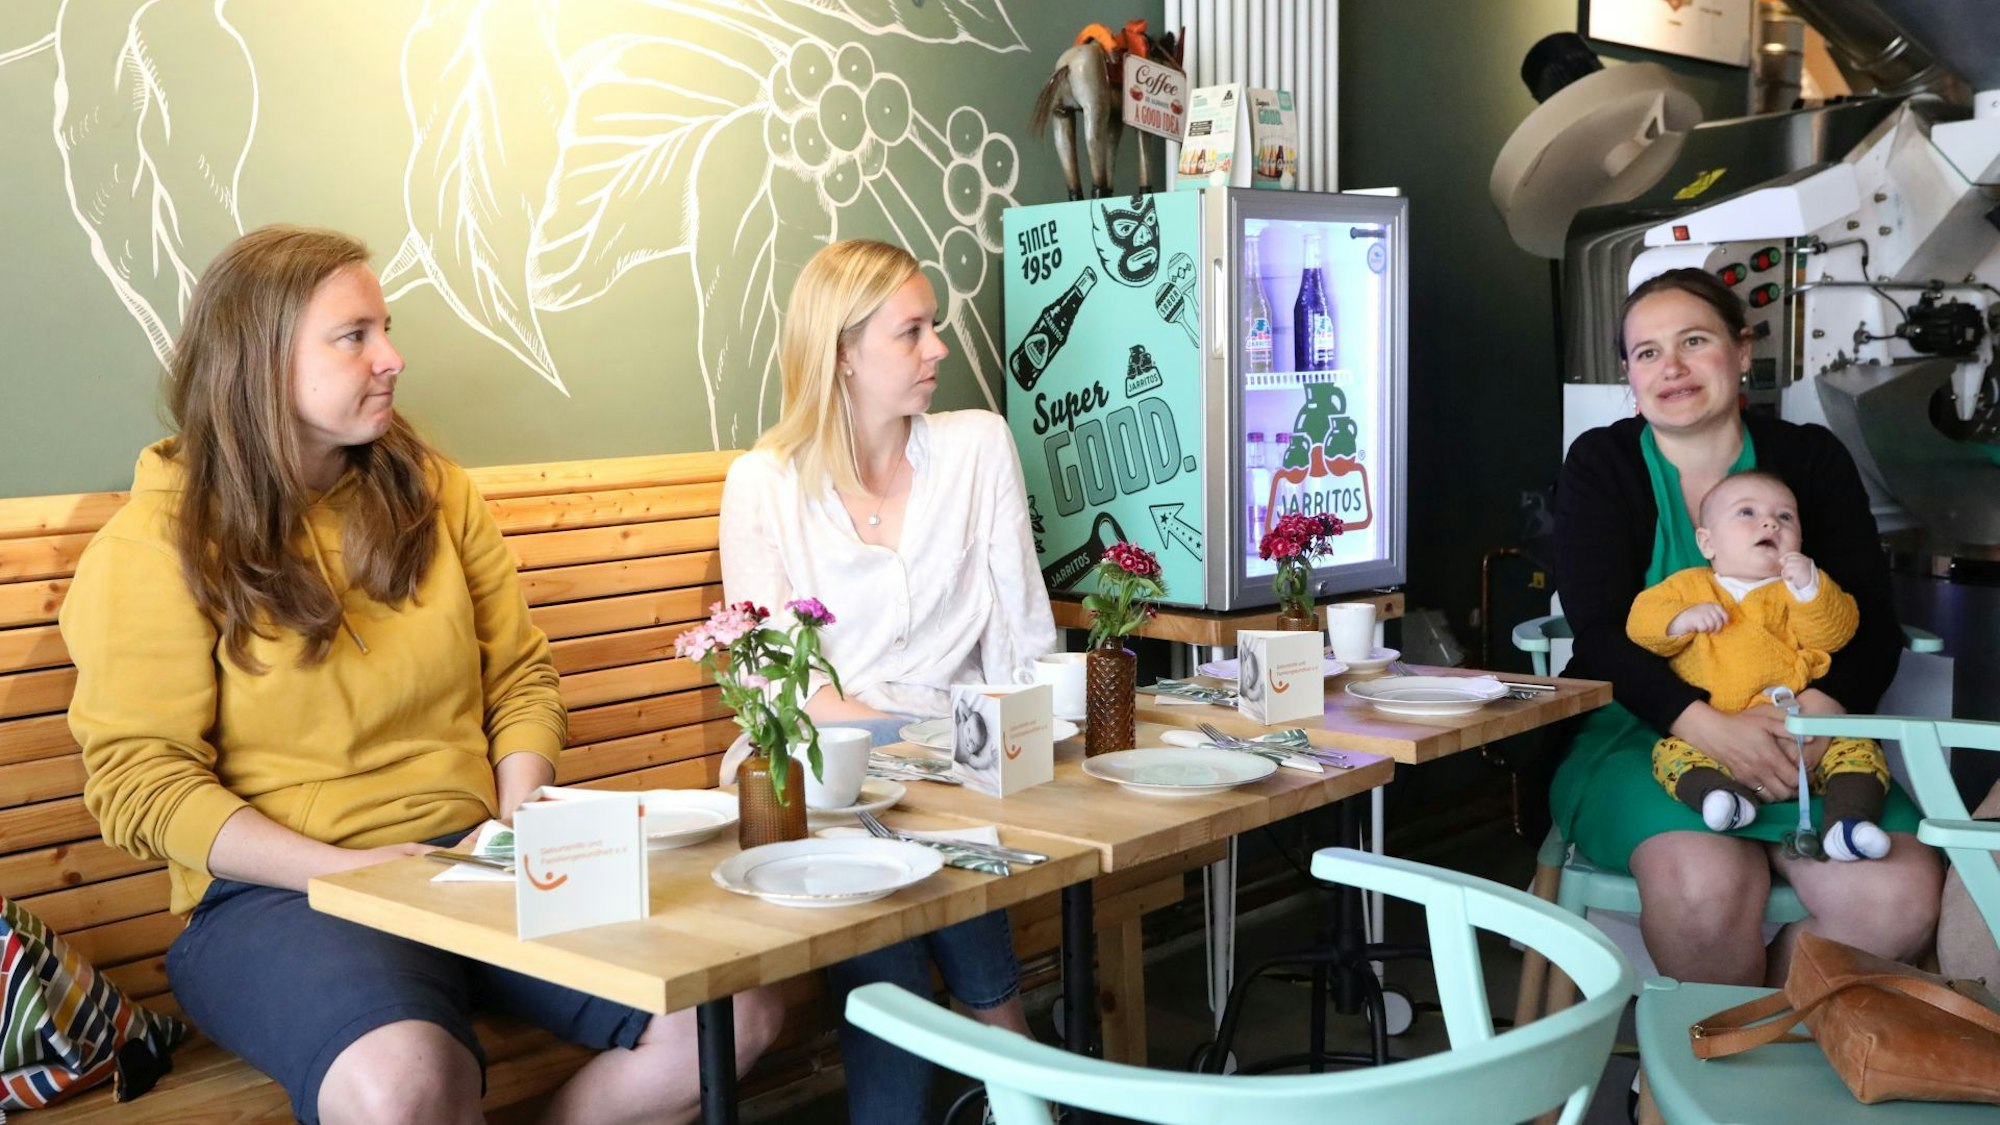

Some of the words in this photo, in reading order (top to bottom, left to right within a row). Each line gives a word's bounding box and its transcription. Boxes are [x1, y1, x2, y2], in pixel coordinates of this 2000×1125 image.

[1135, 65, 1178, 96] Coffee
[1134, 103, 1140, 122] A
[1141, 105, 1161, 129] GOOD
[1162, 111, 1180, 136] IDEA
[1018, 219, 1058, 256] SINCE
[1022, 247, 1062, 285] 1950
[1128, 373, 1159, 393] JARRITOS
[1033, 380, 1109, 435] Super
[1044, 397, 1197, 517] GOOD.
[1276, 487, 1362, 519] JARRITOS
[1050, 552, 1091, 588] JARRITOS
